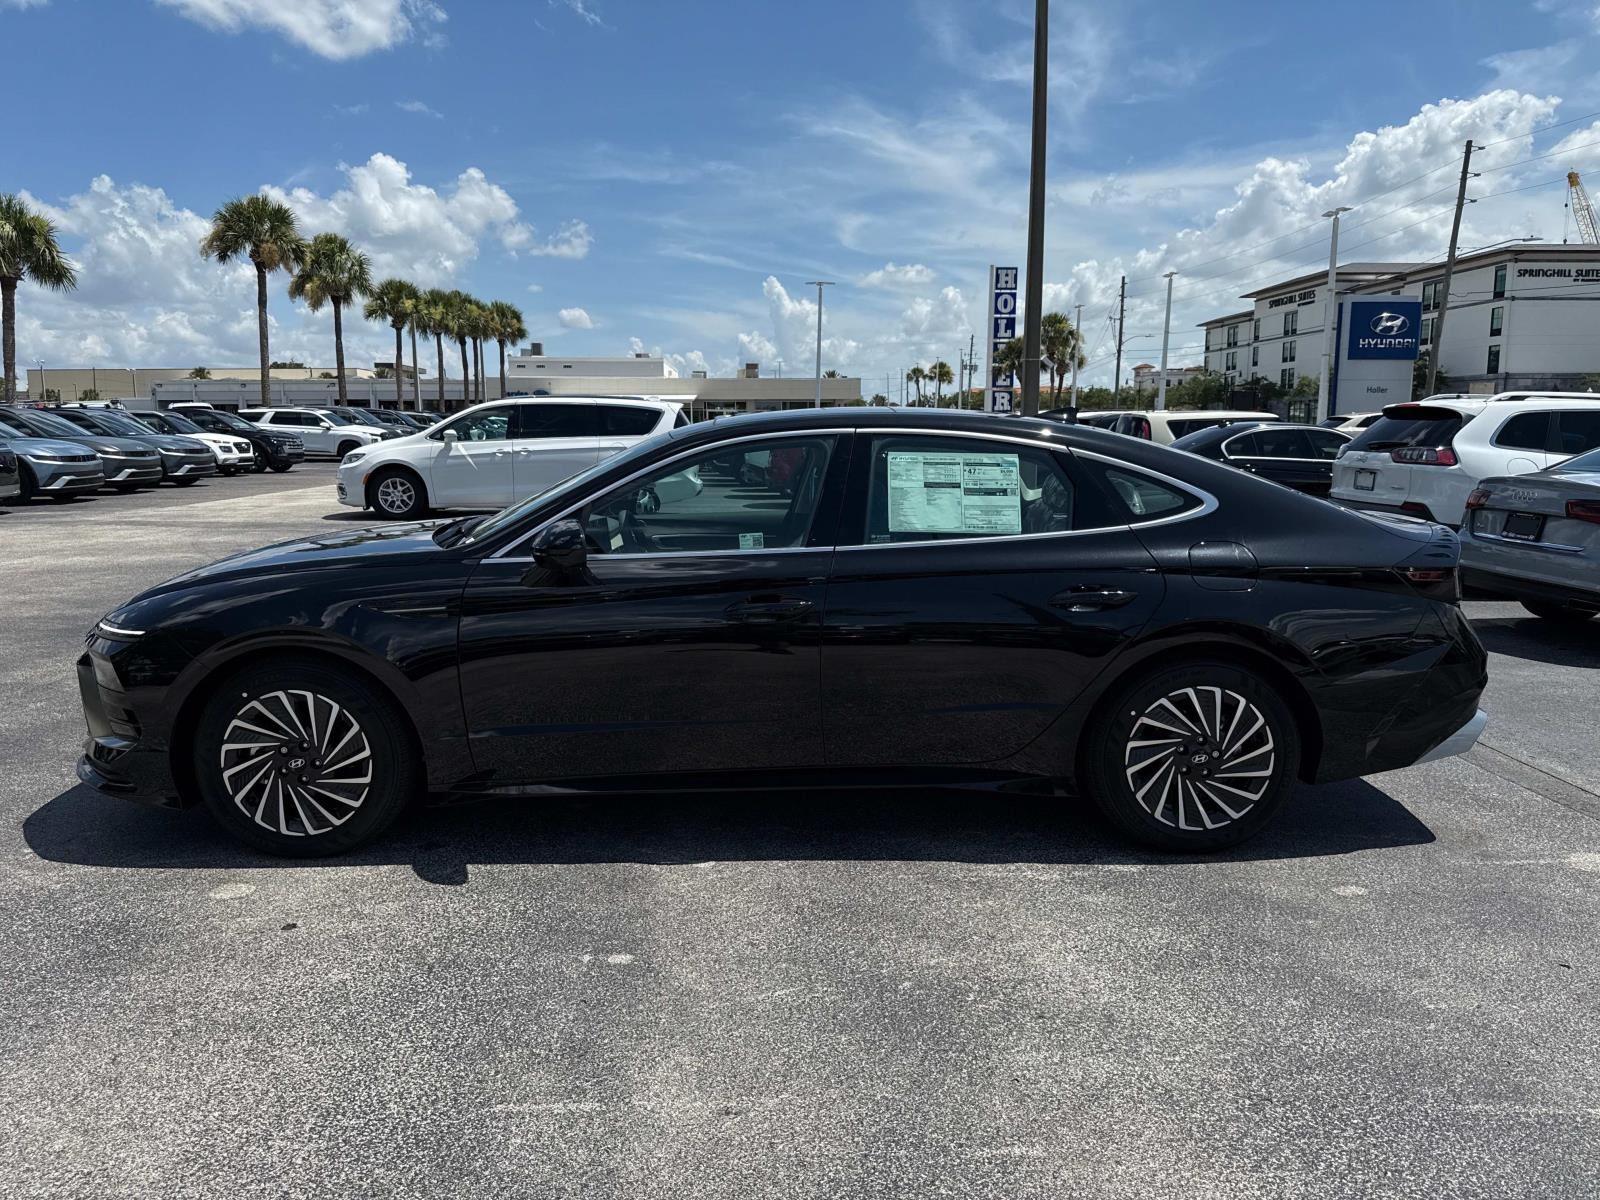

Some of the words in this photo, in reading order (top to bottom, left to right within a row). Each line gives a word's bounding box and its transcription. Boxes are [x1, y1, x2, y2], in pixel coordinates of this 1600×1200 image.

[1517, 268, 1572, 278] SPRINGHILL
[994, 269, 1017, 411] HOLER
[1359, 338, 1416, 348] HYUNDAI
